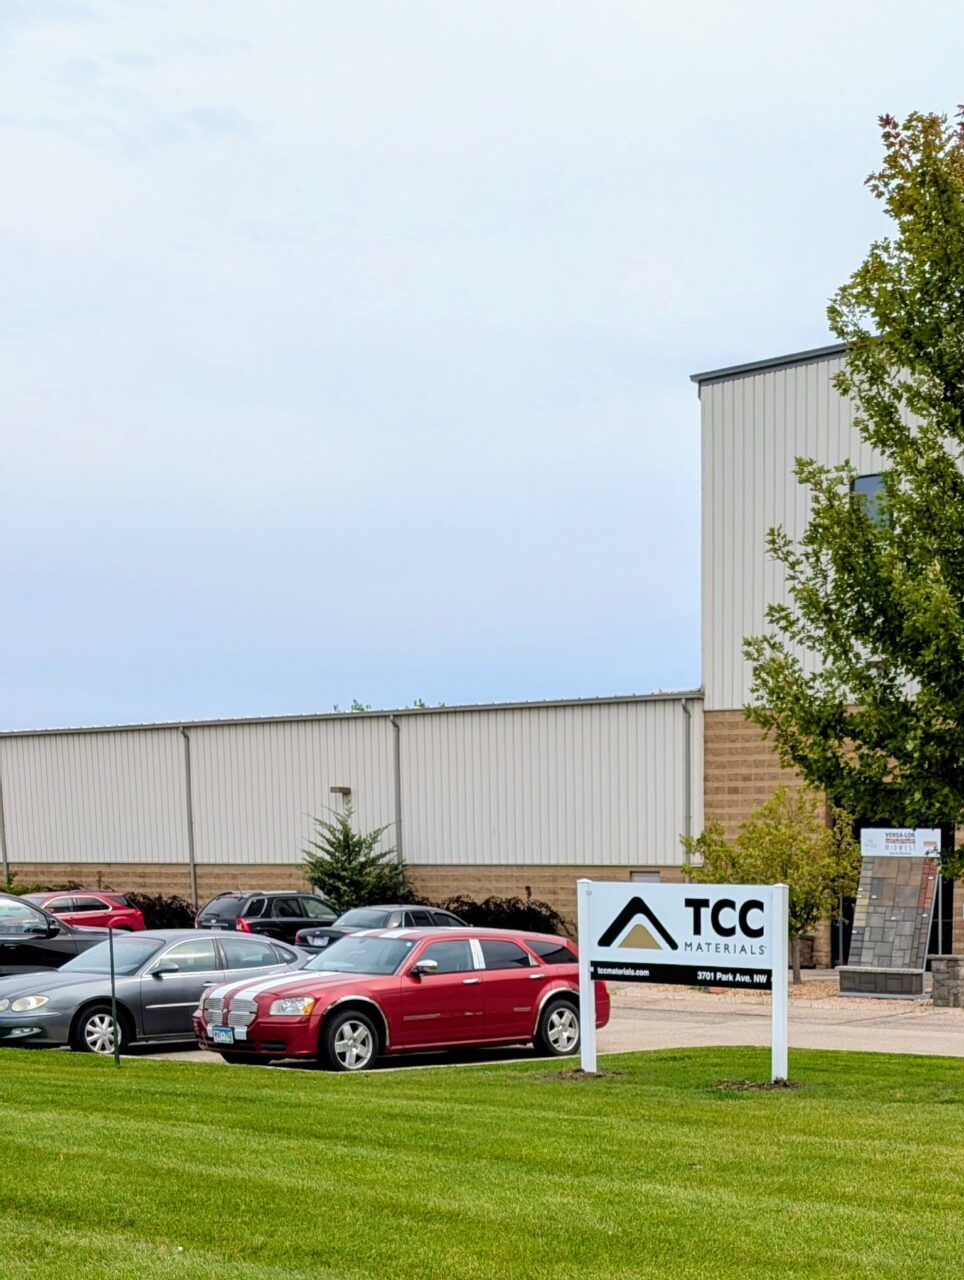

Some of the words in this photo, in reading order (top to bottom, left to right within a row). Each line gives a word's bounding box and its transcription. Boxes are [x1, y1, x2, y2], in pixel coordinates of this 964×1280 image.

[684, 898, 764, 938] TCC
[684, 942, 765, 955] MATERIALS
[597, 966, 650, 976] tccmaterials.com
[697, 971, 714, 980] 3701
[716, 972, 734, 981] Park
[735, 973, 752, 982] Ave.
[753, 974, 767, 983] NW
